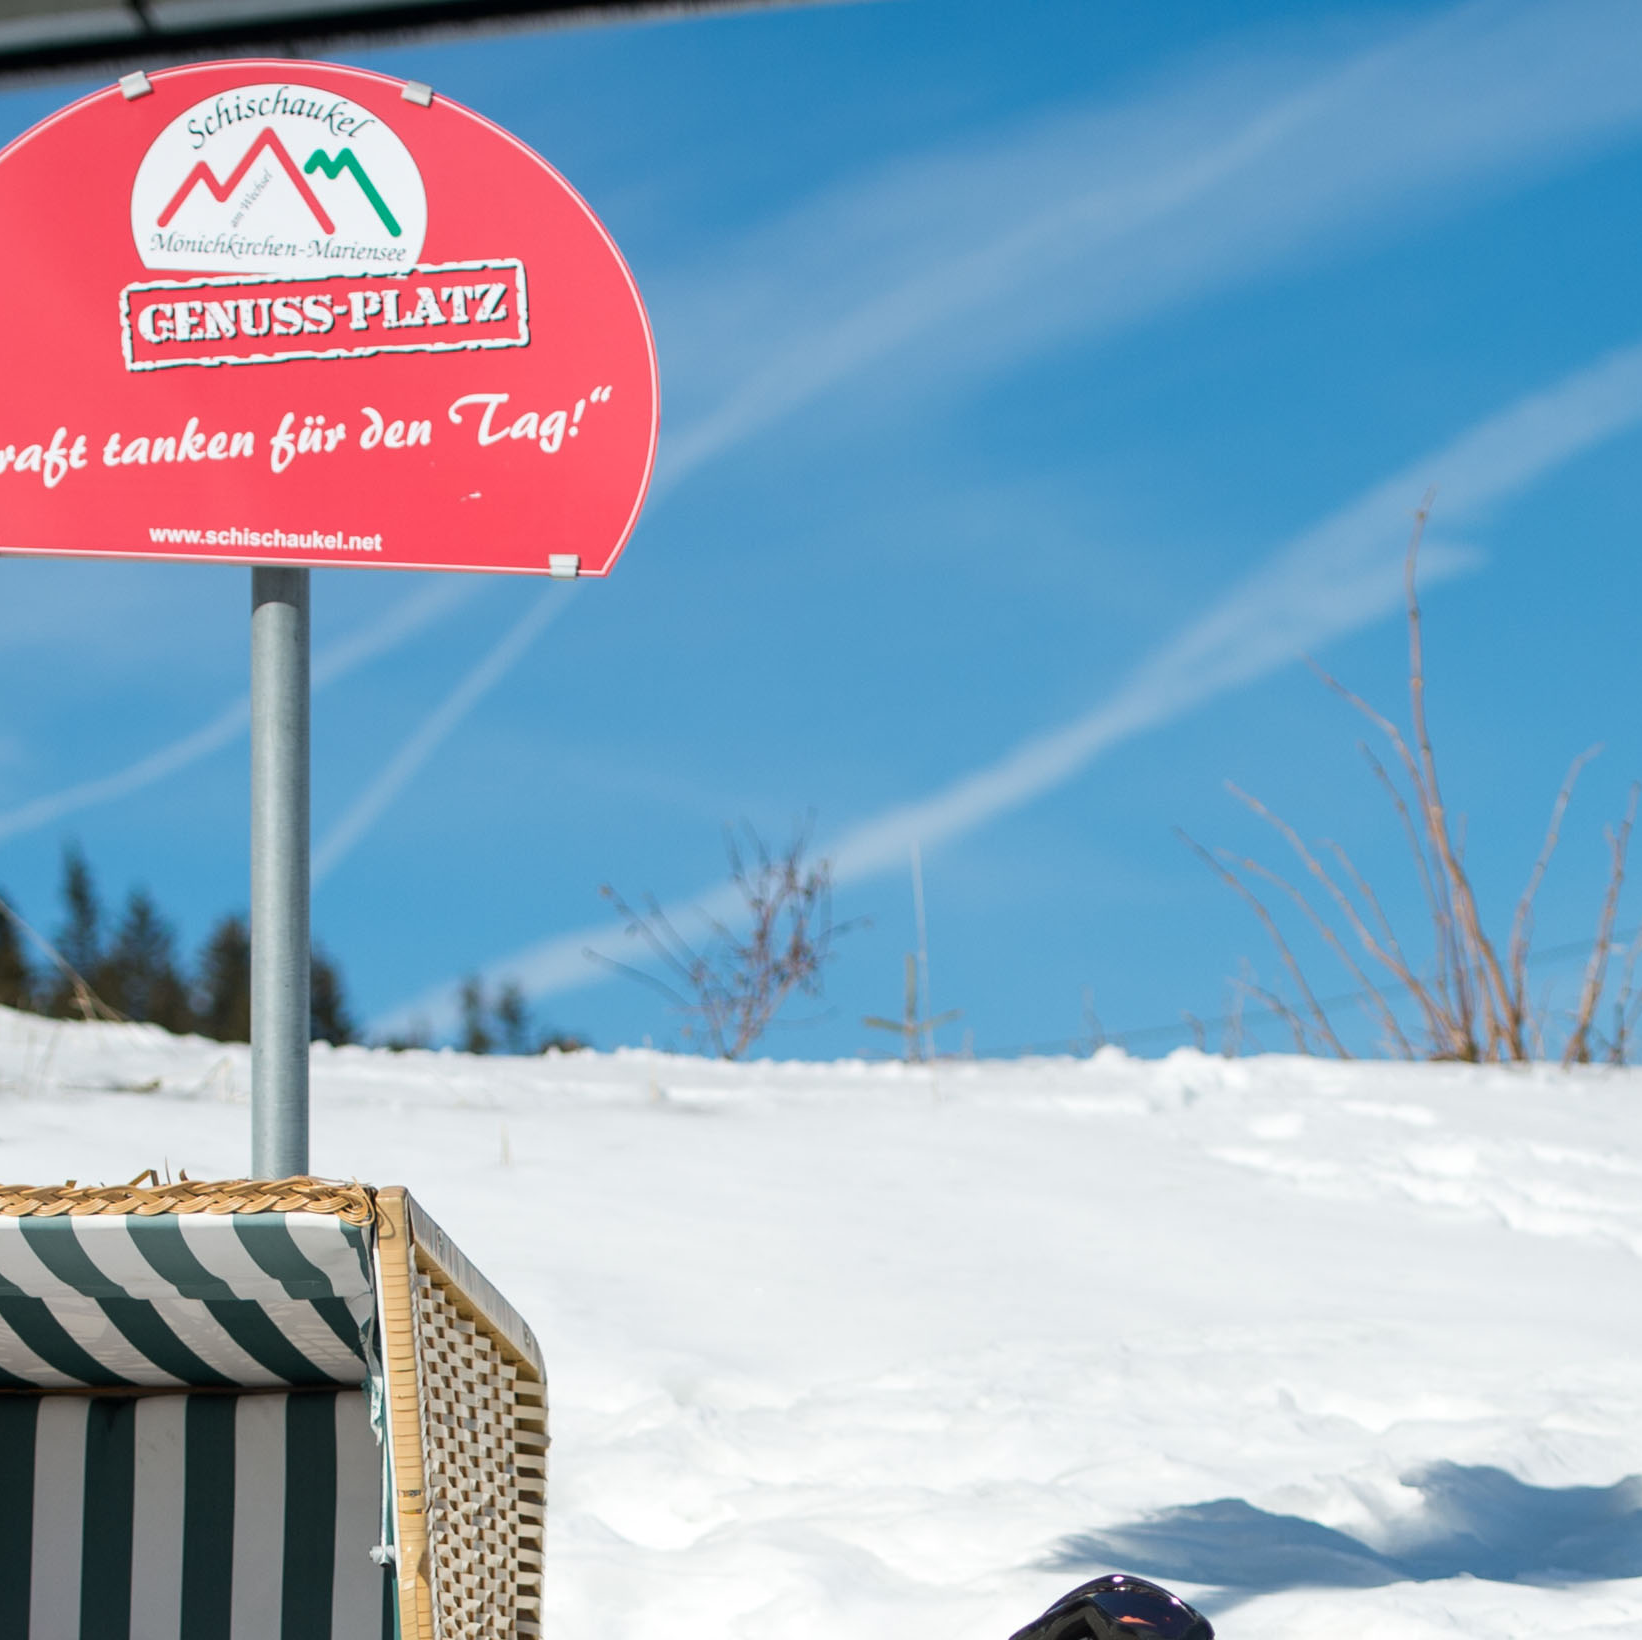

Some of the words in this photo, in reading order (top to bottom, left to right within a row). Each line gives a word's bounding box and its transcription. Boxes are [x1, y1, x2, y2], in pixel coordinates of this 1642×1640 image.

[187, 86, 375, 150] Schischaukel
[149, 231, 407, 262] Mönichkirchen-Mariensee
[137, 282, 510, 344] GENUSS-PLATZ
[102, 416, 255, 468] tanken
[269, 411, 347, 474] für
[359, 406, 433, 451] den
[148, 526, 383, 552] www.schischaukel.net
